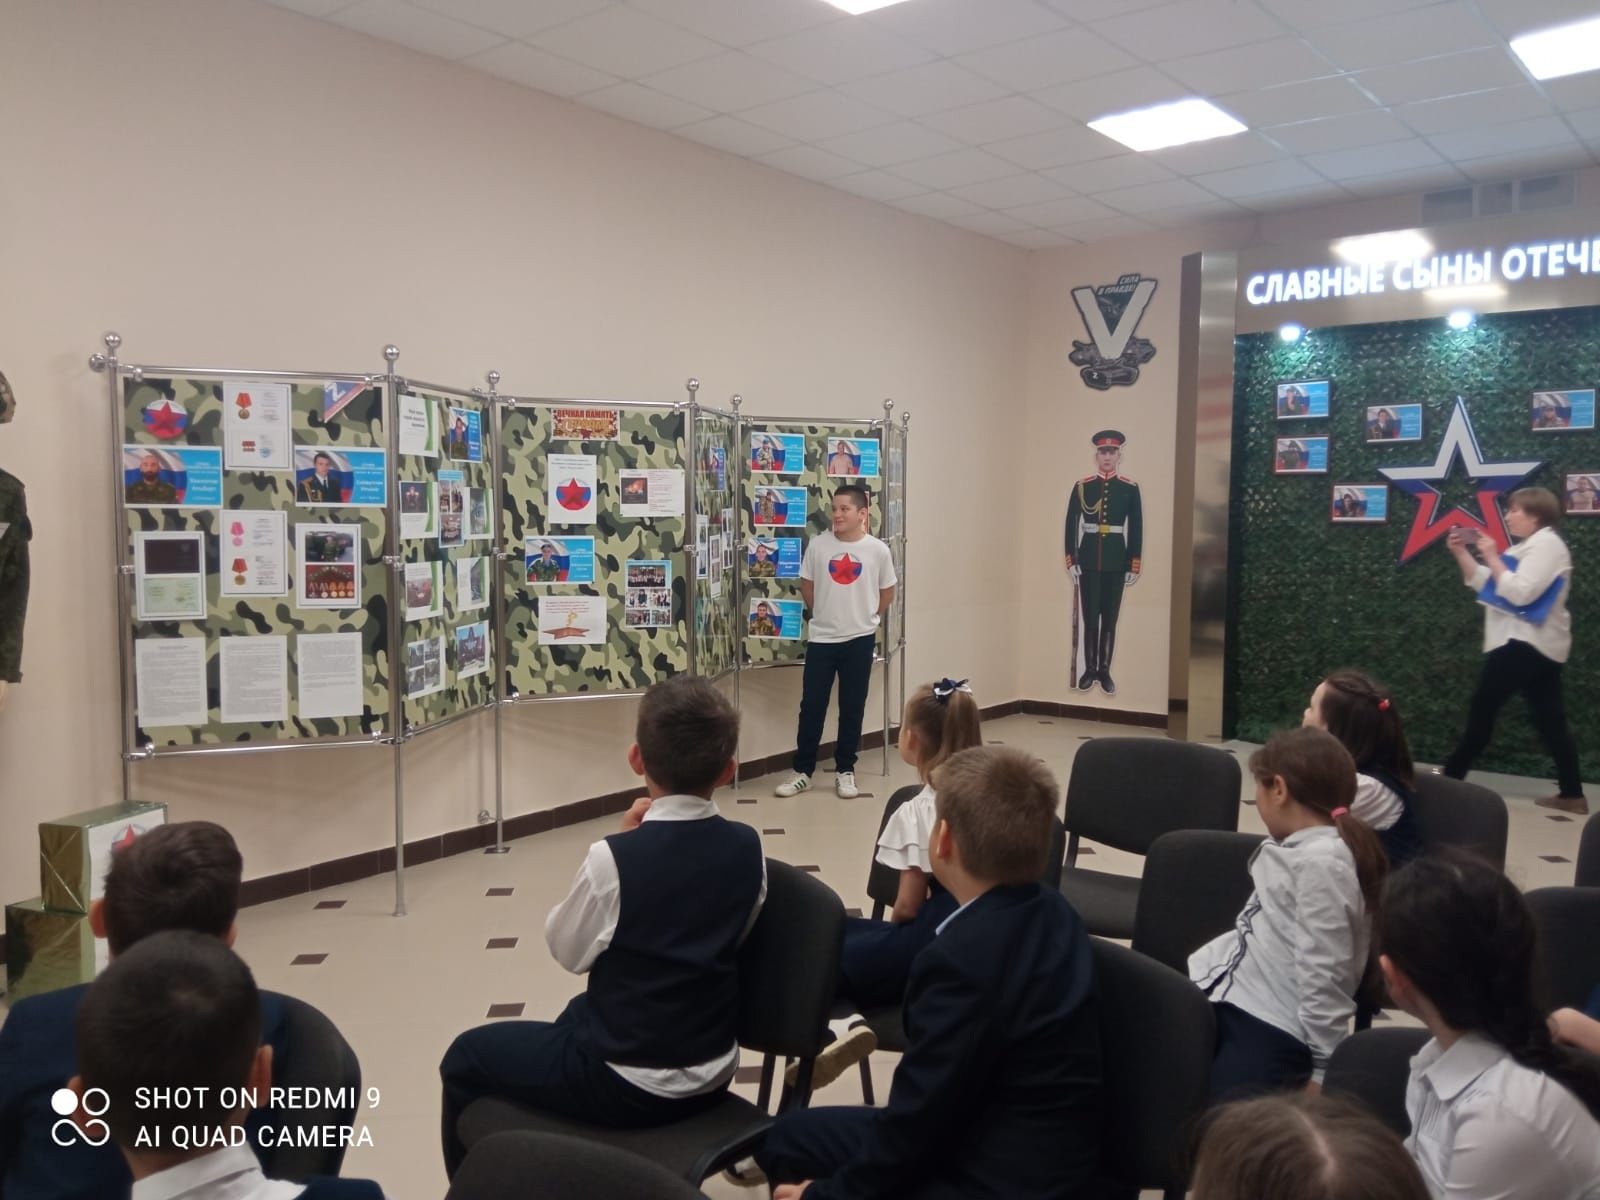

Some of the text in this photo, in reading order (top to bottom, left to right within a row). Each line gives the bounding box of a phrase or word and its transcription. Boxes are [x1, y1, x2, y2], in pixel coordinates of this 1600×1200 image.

[1246, 261, 1385, 305] СЛАВНЫЕ
[1392, 251, 1492, 291] СЫНЫ
[1073, 280, 1156, 360] V
